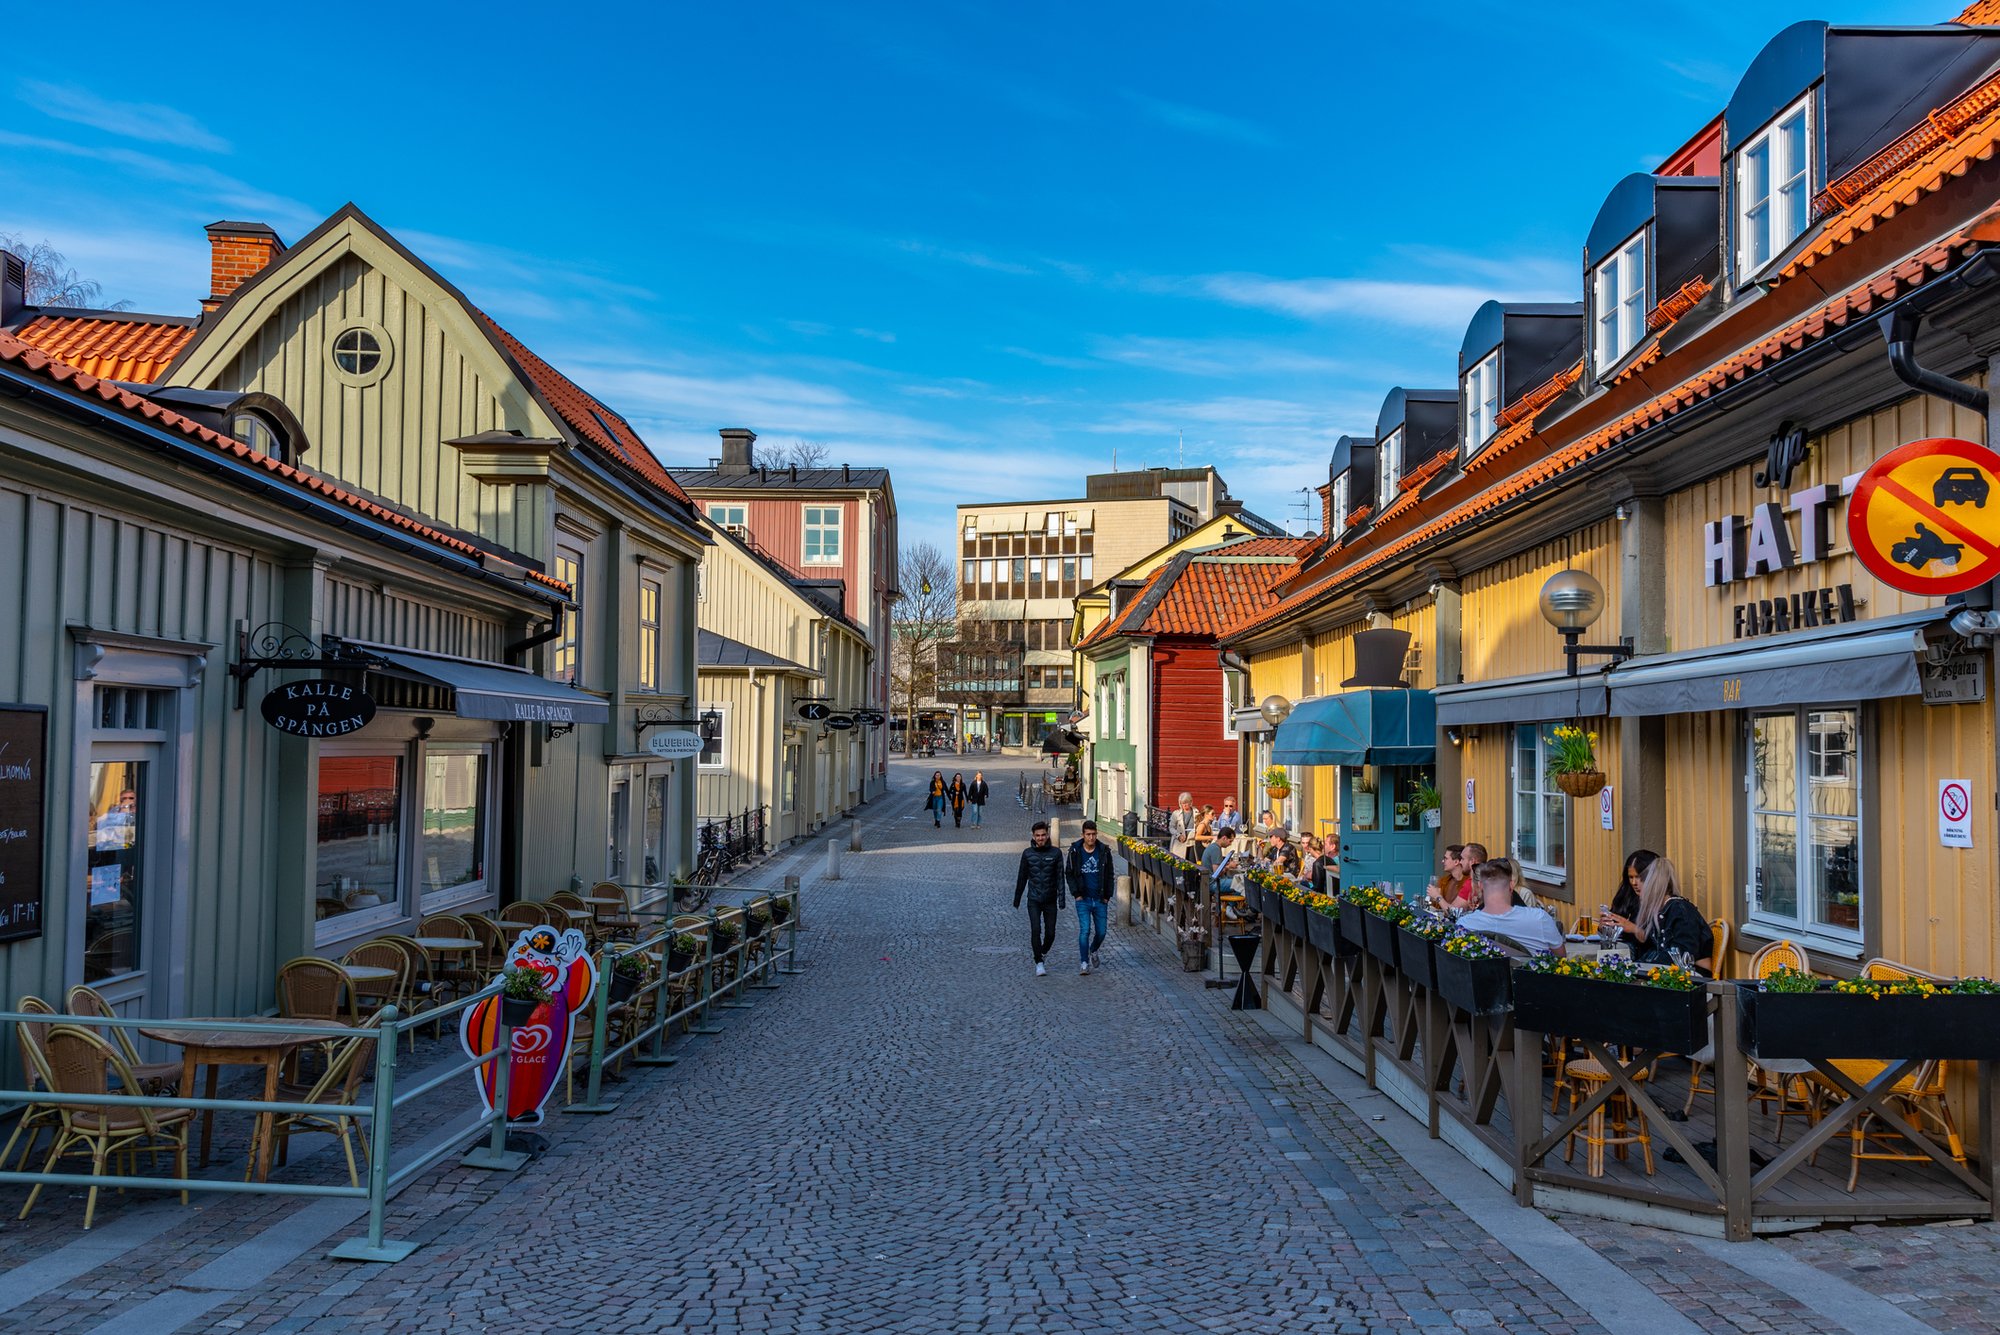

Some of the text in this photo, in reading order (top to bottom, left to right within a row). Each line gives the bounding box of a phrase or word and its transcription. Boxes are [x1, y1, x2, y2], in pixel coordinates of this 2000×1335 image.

[1704, 471, 1866, 587] HAT
[1733, 583, 1857, 639] FABRIKEN
[1925, 661, 1978, 681] Kgsgatan
[286, 683, 353, 700] KALLE
[1723, 678, 1741, 704] BAR
[1972, 678, 1978, 696] 1
[307, 701, 330, 716] PÅ
[514, 701, 573, 721] KALLE PÅ SPÅNGEN
[809, 705, 820, 719] K
[275, 714, 364, 736] SPÅNGEN
[652, 737, 700, 748] BLUEBIRD
[516, 1055, 547, 1063] GLACE
